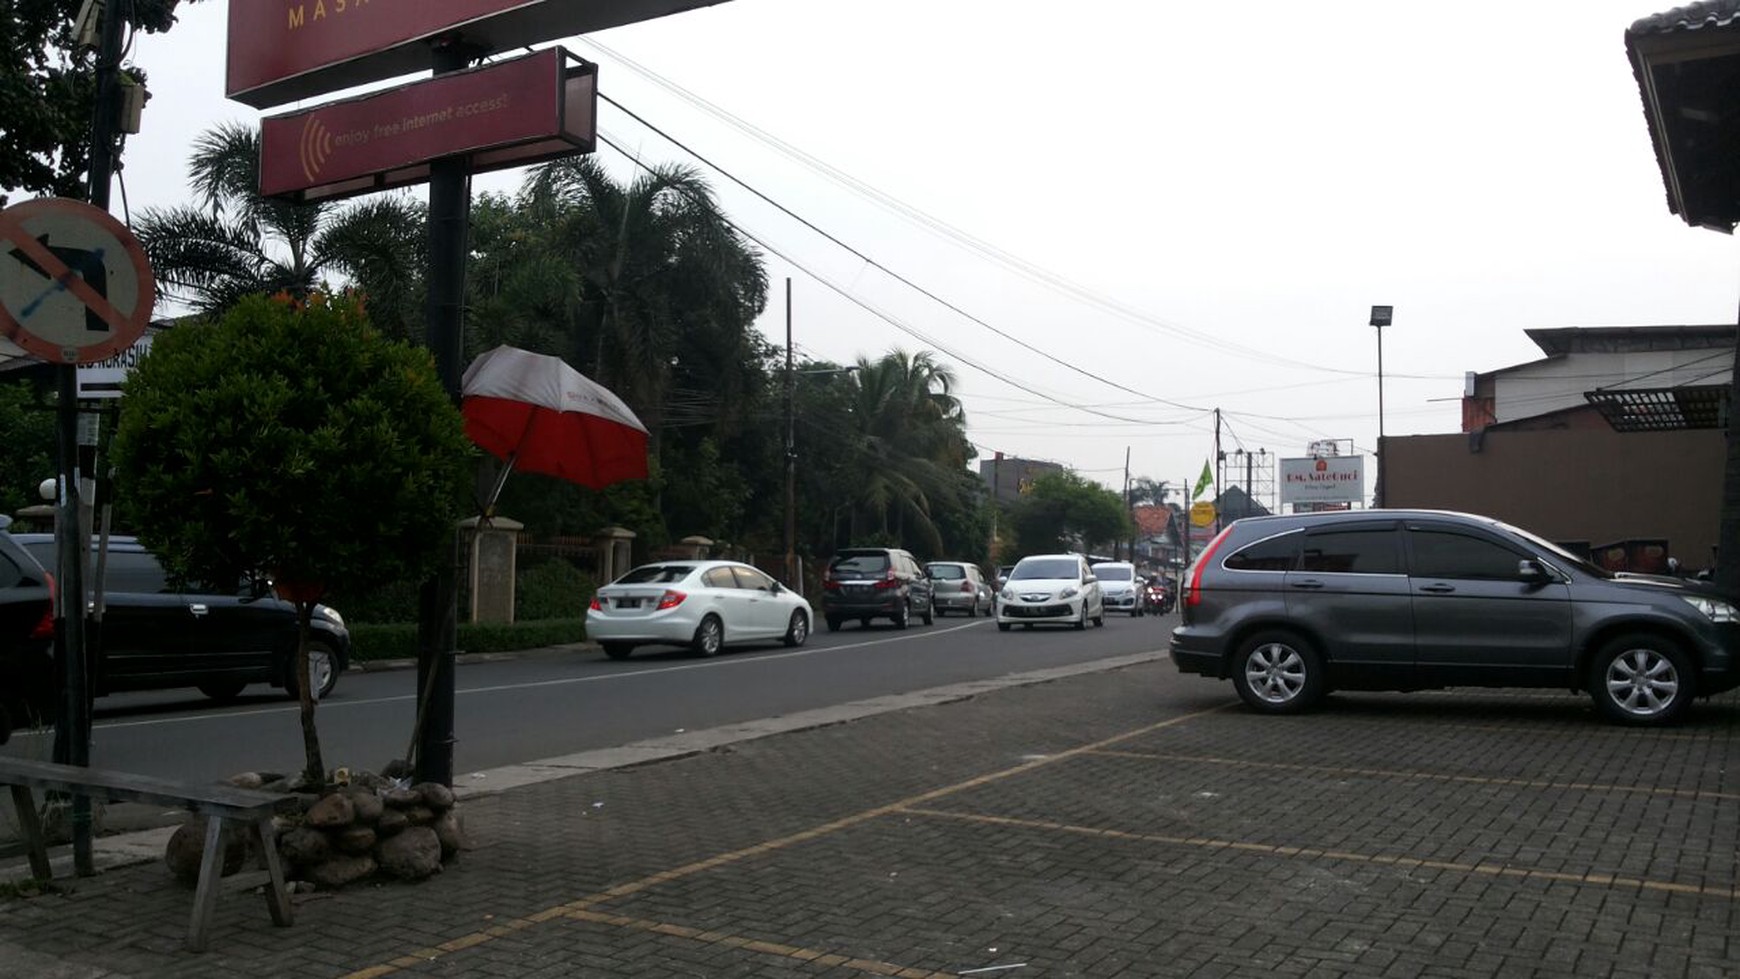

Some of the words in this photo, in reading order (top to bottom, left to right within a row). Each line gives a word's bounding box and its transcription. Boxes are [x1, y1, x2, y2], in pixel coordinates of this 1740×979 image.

[335, 129, 370, 146] enjoy
[374, 123, 401, 139] free
[403, 106, 454, 132] internet
